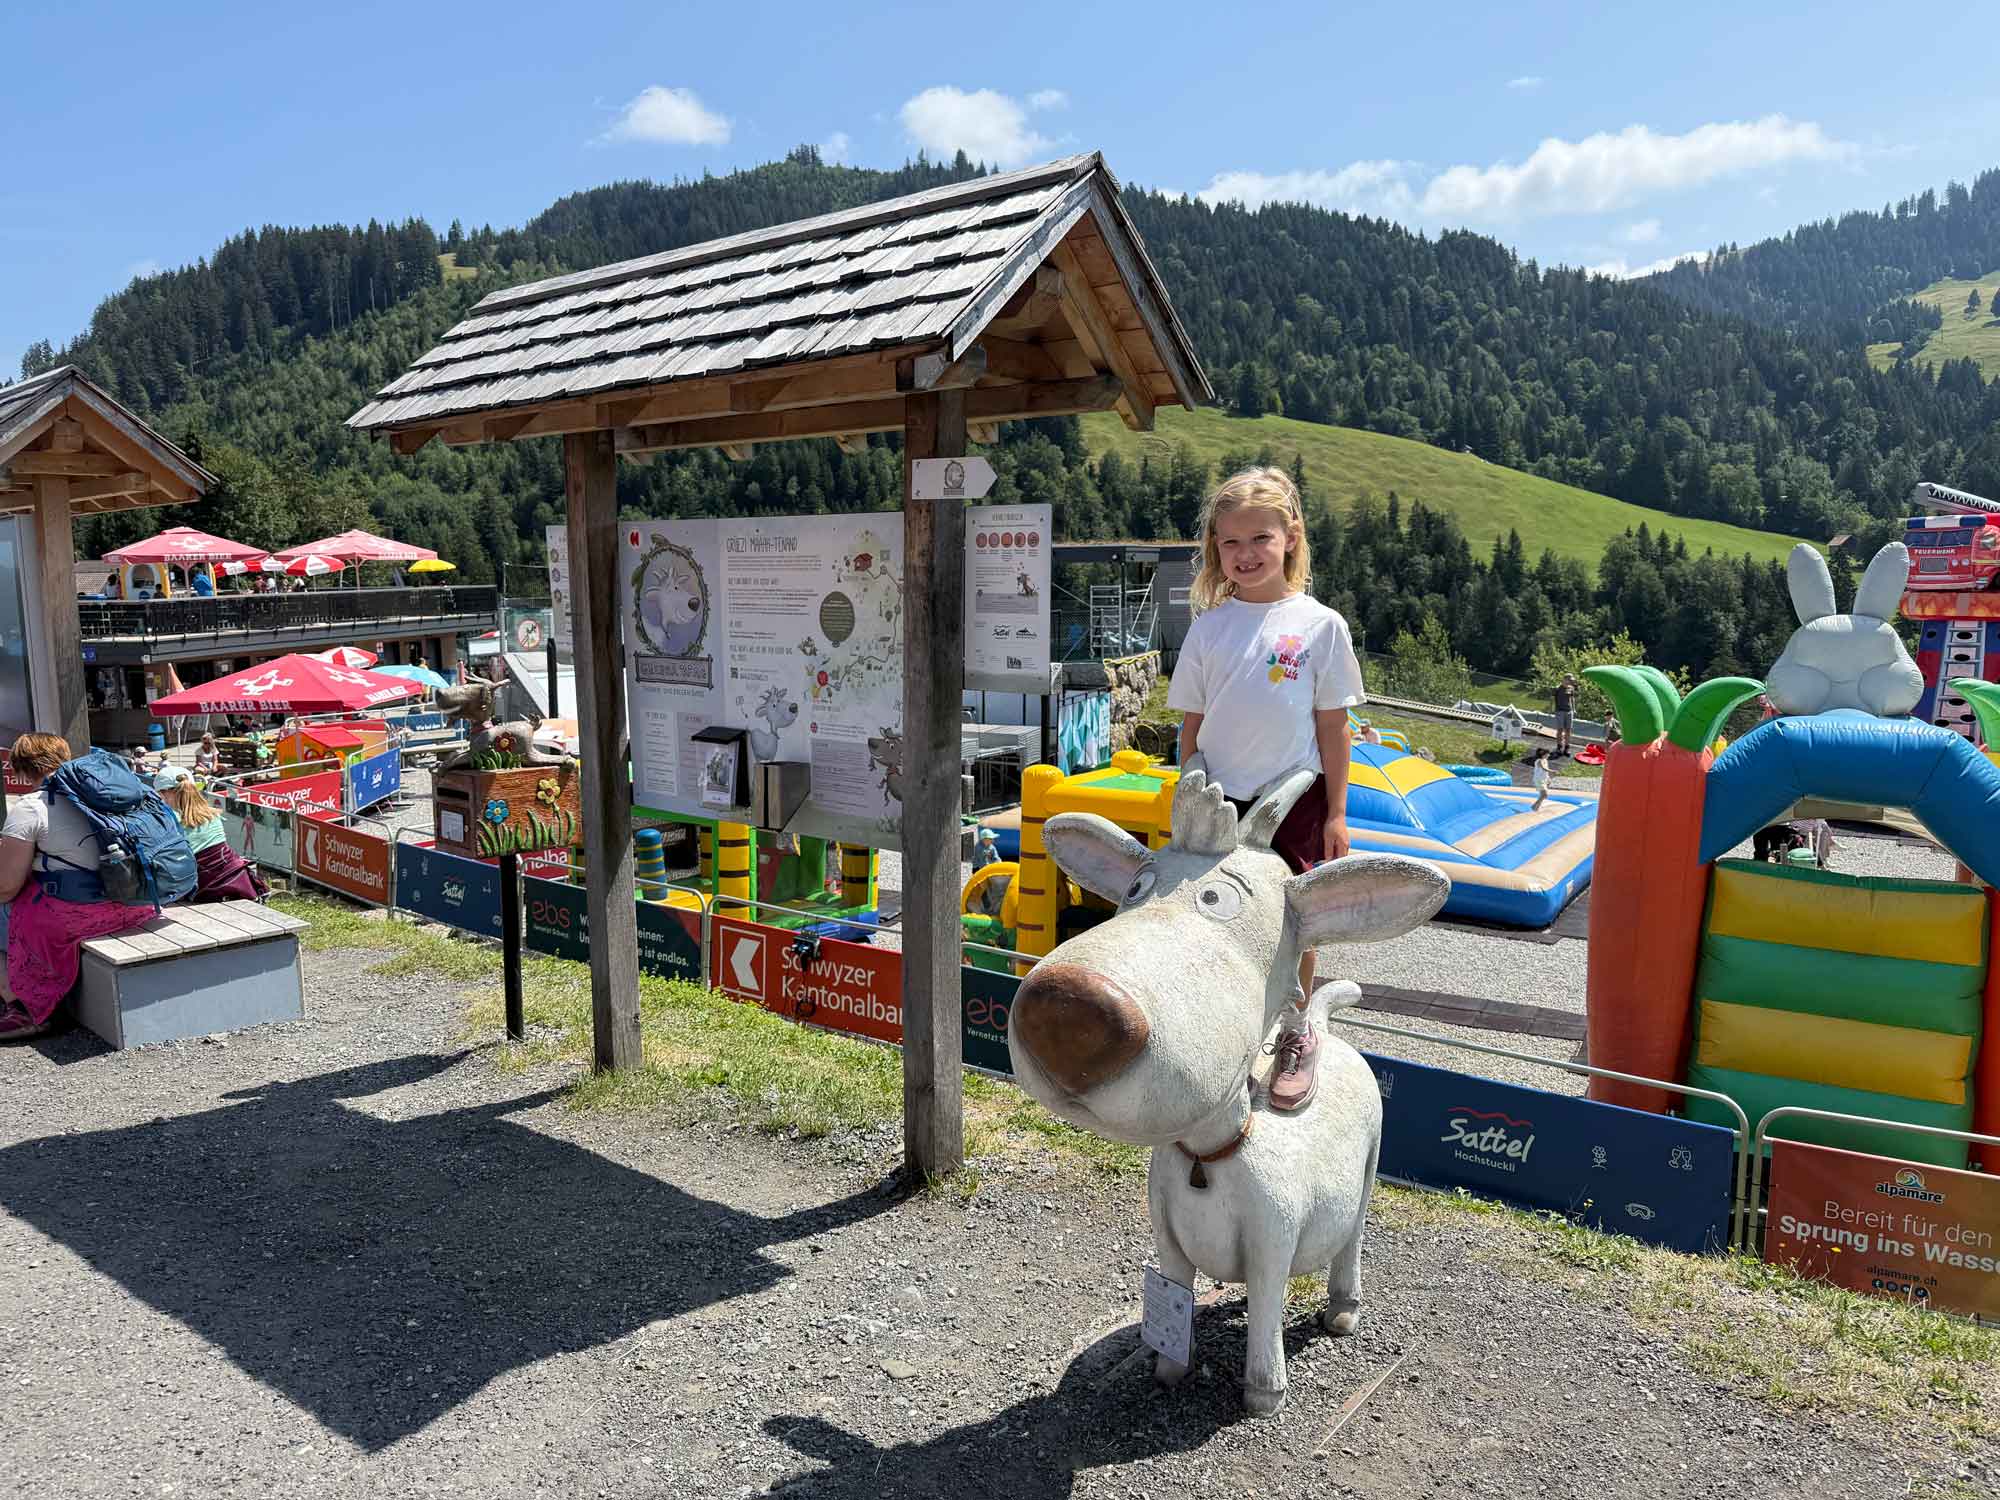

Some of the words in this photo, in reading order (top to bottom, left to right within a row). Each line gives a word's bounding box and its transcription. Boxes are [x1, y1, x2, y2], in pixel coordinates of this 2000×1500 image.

[200, 700, 256, 713] BAARER
[260, 700, 293, 711] BIER
[325, 833, 363, 862] Schwyzer
[326, 853, 384, 889] Kantonalbank
[531, 898, 571, 929] ebs
[638, 928, 664, 943] einen:
[645, 946, 656, 959] ist
[657, 952, 689, 967] endlos.
[782, 975, 902, 1025] Kantonalba
[966, 996, 1009, 1031] eb
[967, 1026, 998, 1041] Vernetzt
[1441, 1119, 1535, 1163] Sattel
[1454, 1150, 1516, 1173] Hochstuckli
[1875, 1182, 1944, 1204] alpamare
[1779, 1215, 1869, 1252] Sprung
[1877, 1233, 1916, 1257] ins
[1824, 1200, 1894, 1231] Bereit
[1903, 1214, 1938, 1238] für
[1945, 1224, 1993, 1249] den
[1866, 1264, 1937, 1286] alpamare.ch
